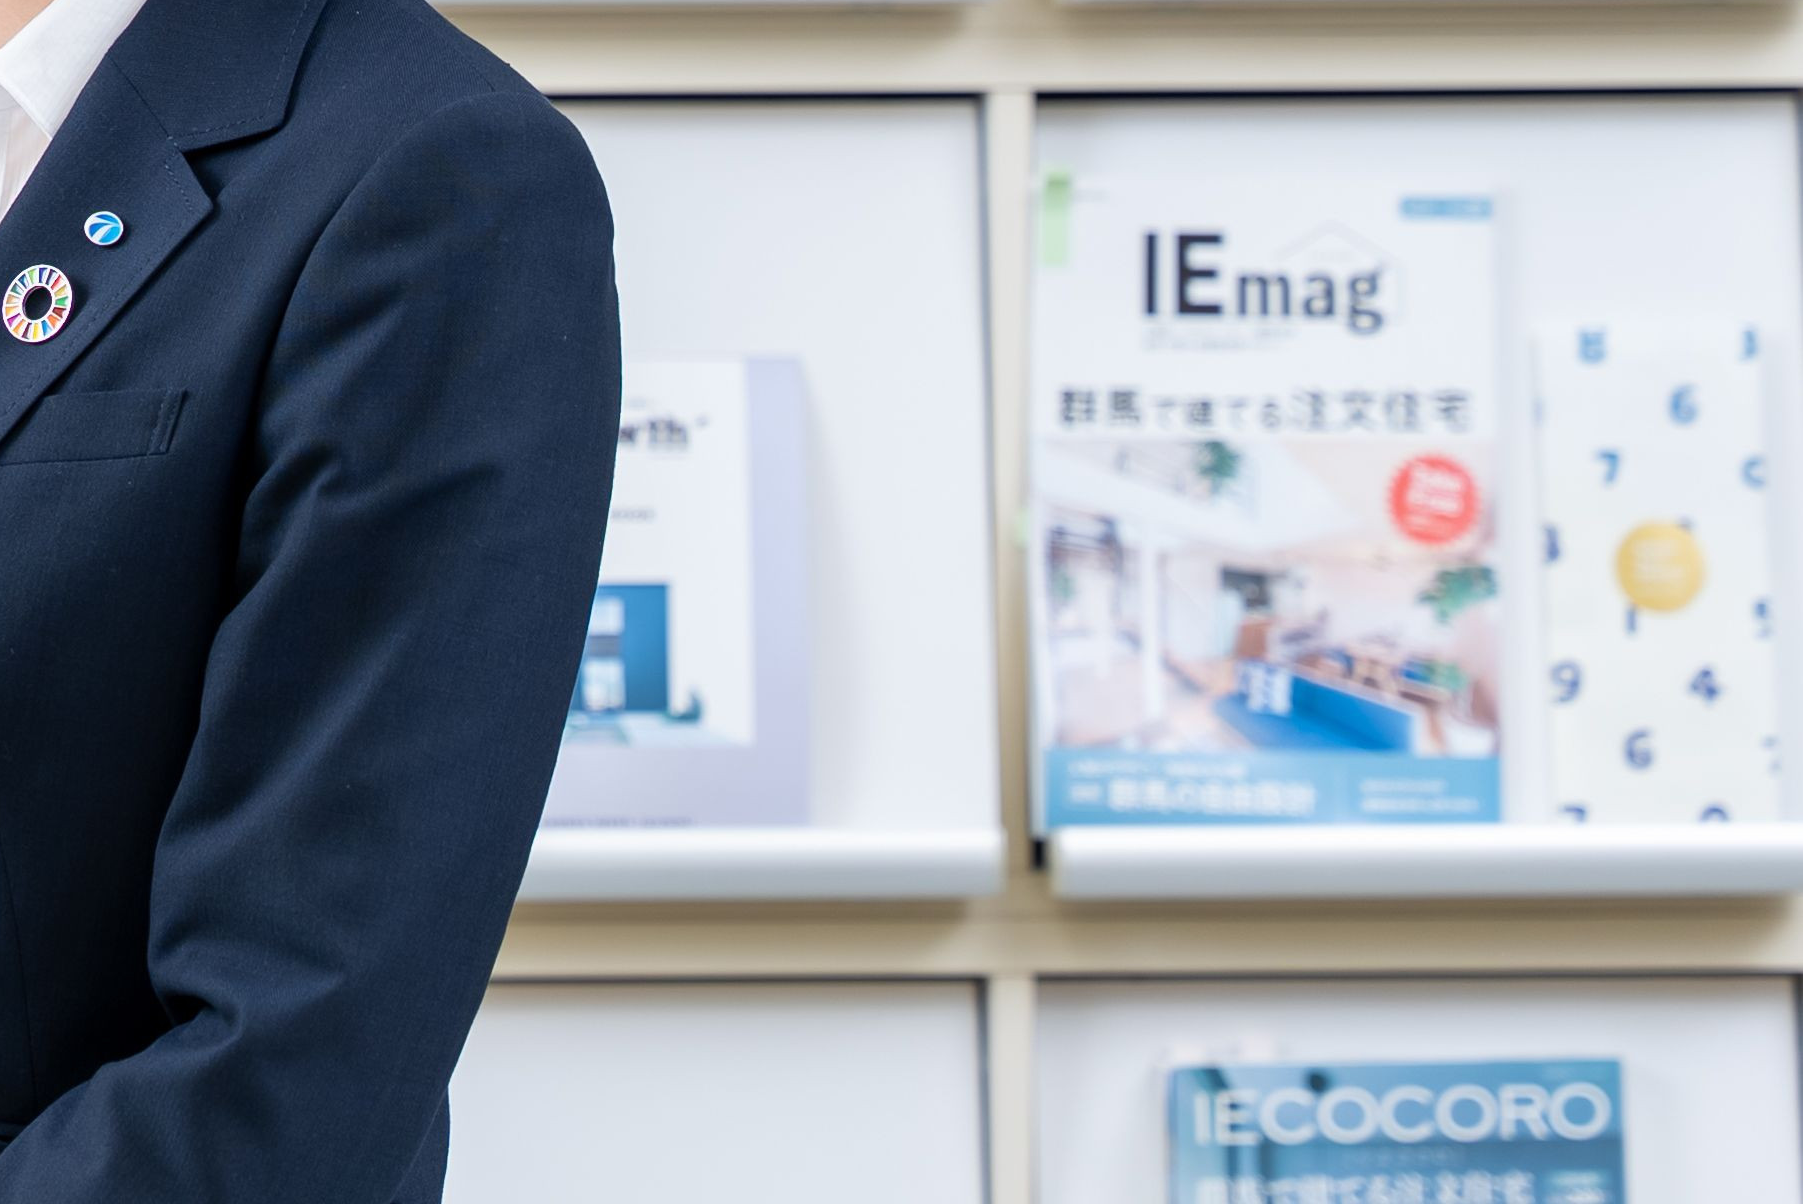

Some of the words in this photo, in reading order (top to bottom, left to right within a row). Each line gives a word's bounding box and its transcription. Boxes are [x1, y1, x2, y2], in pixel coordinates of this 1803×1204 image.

[1059, 388, 1472, 434] 群馬で建てる注文住宅
[1668, 384, 1700, 426] 6
[1549, 659, 1584, 704] 9
[1623, 727, 1655, 770] 6
[1194, 1082, 1613, 1146] IECOCORO
